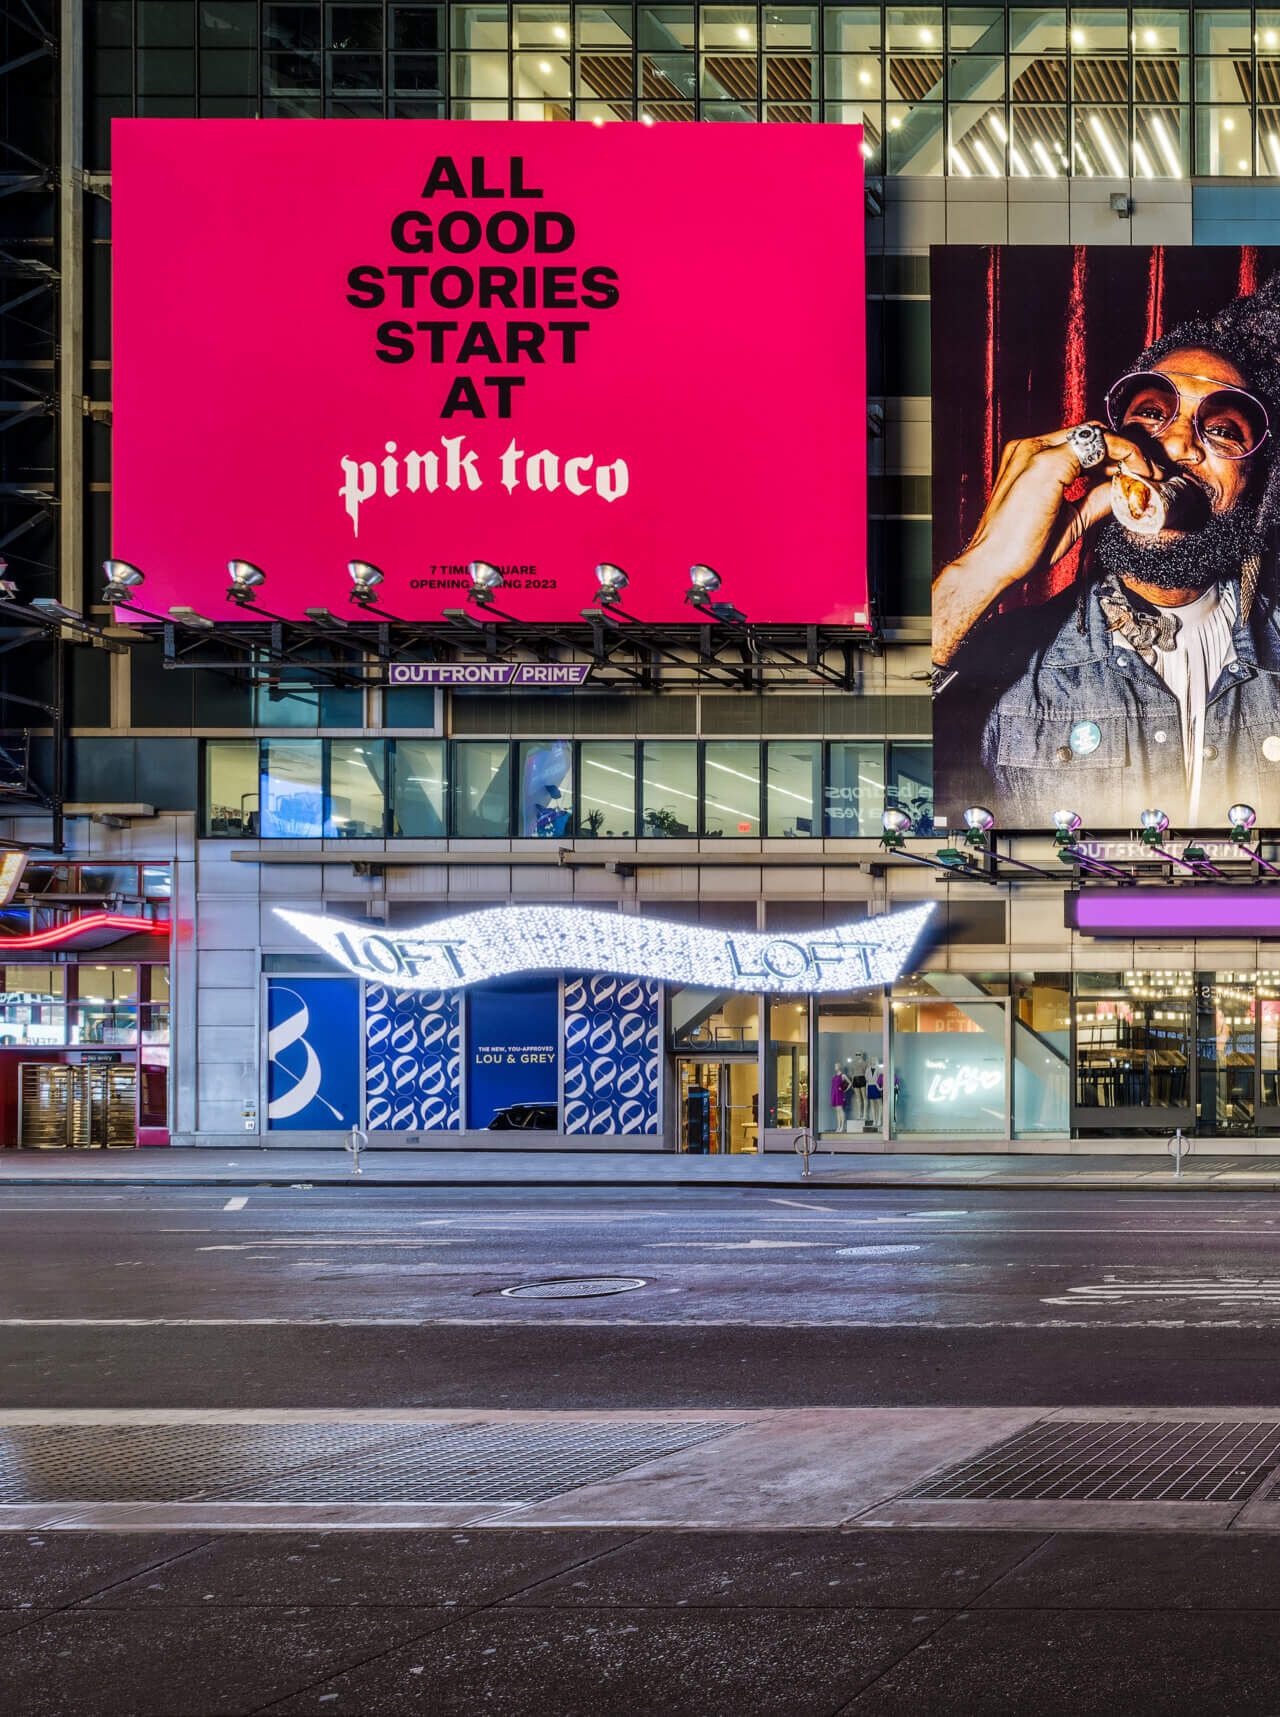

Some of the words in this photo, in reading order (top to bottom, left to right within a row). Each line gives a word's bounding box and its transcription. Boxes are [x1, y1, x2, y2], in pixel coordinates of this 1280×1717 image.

[422, 157, 543, 198] ALL
[391, 211, 575, 253] GOOD
[347, 266, 619, 309] STORIES
[376, 321, 589, 363] START
[440, 377, 525, 418] AT
[338, 435, 483, 538] pink
[498, 437, 629, 502] taco
[410, 579, 470, 589] OPENING
[525, 579, 557, 589] 2023
[429, 566, 437, 575] 7
[440, 566, 471, 575] TIME
[494, 566, 537, 575] UARE
[394, 666, 509, 682] OUTFRONT
[522, 667, 580, 682] PRIME
[334, 932, 466, 978] LOFT
[725, 939, 883, 981] LOFT
[674, 1026, 752, 1050] LOFT
[475, 1054, 502, 1064] LOU
[506, 1054, 516, 1064] &
[520, 1054, 555, 1064] GREY
